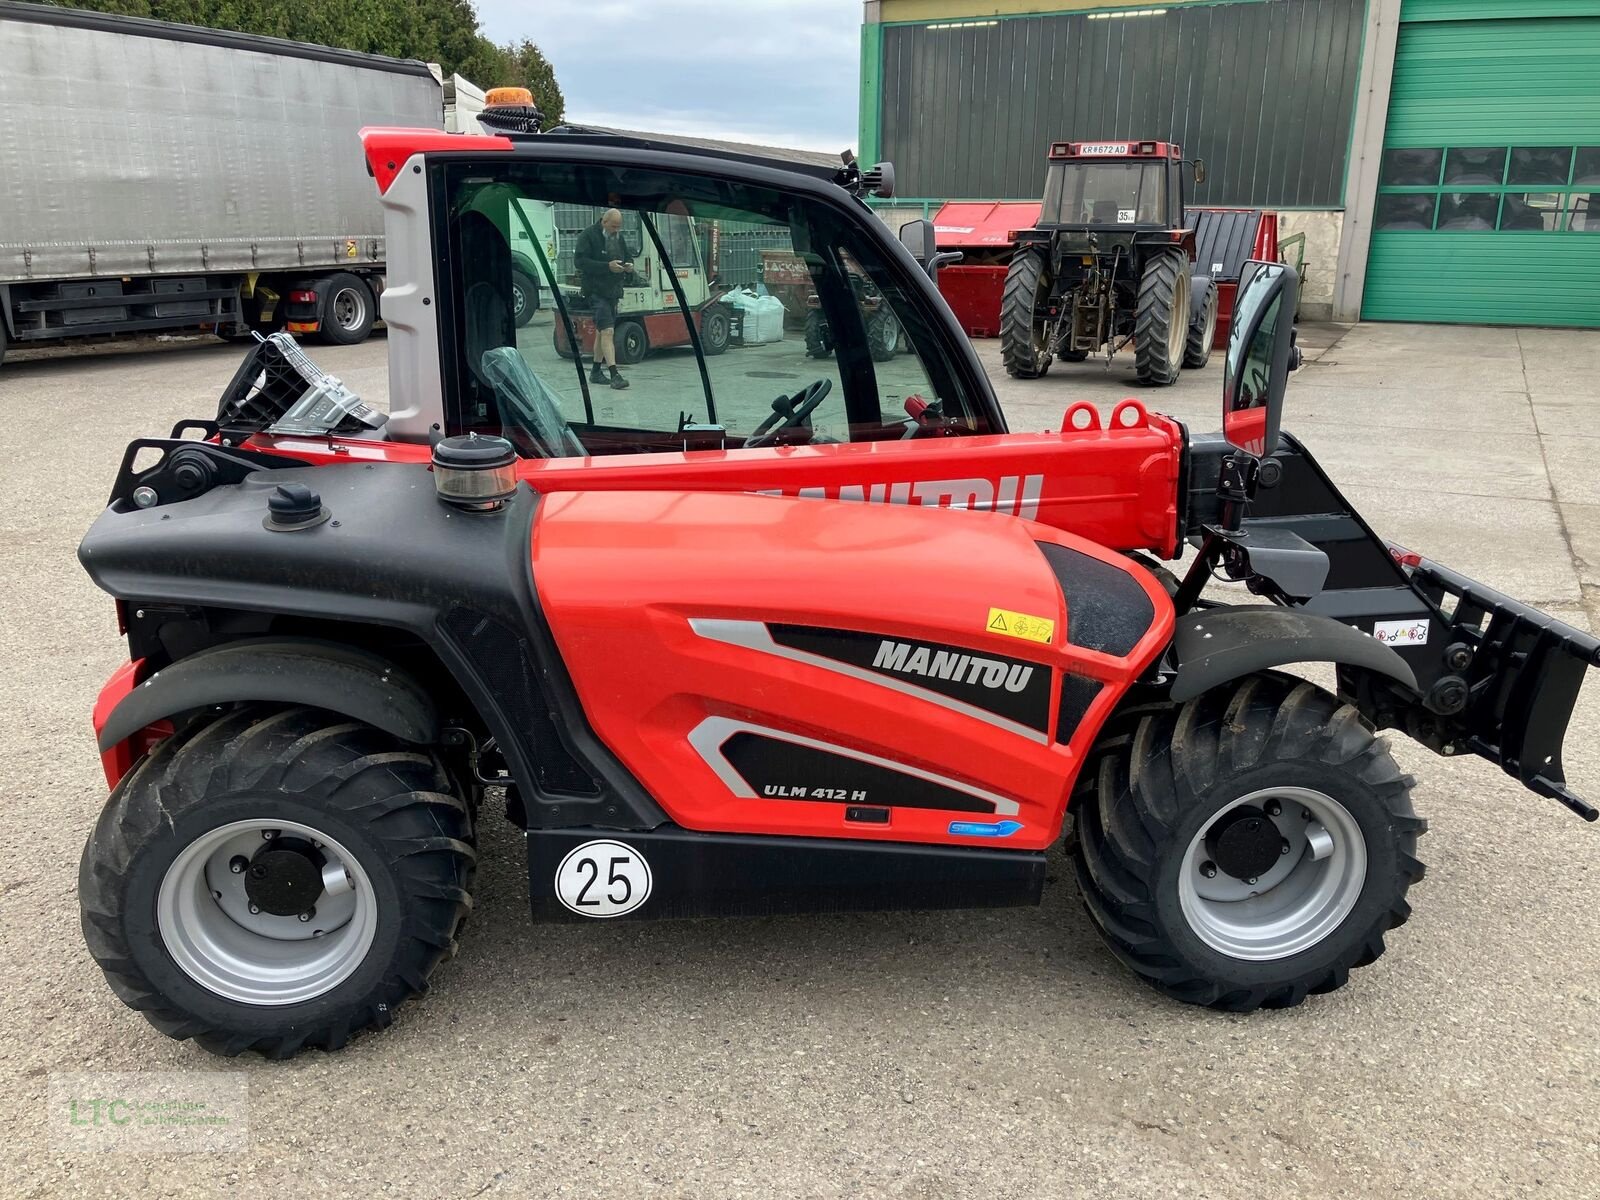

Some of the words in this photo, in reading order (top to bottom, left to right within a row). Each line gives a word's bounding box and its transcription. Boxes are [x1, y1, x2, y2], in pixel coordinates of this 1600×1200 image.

[1082, 146, 1093, 154] KR
[1098, 145, 1113, 154] 672
[1115, 145, 1125, 154] AD
[634, 292, 645, 303] 13
[872, 640, 1034, 693] MANITOU
[764, 785, 807, 798] ULM
[811, 788, 847, 800] 412
[851, 790, 866, 801] H
[576, 857, 631, 906] 25
